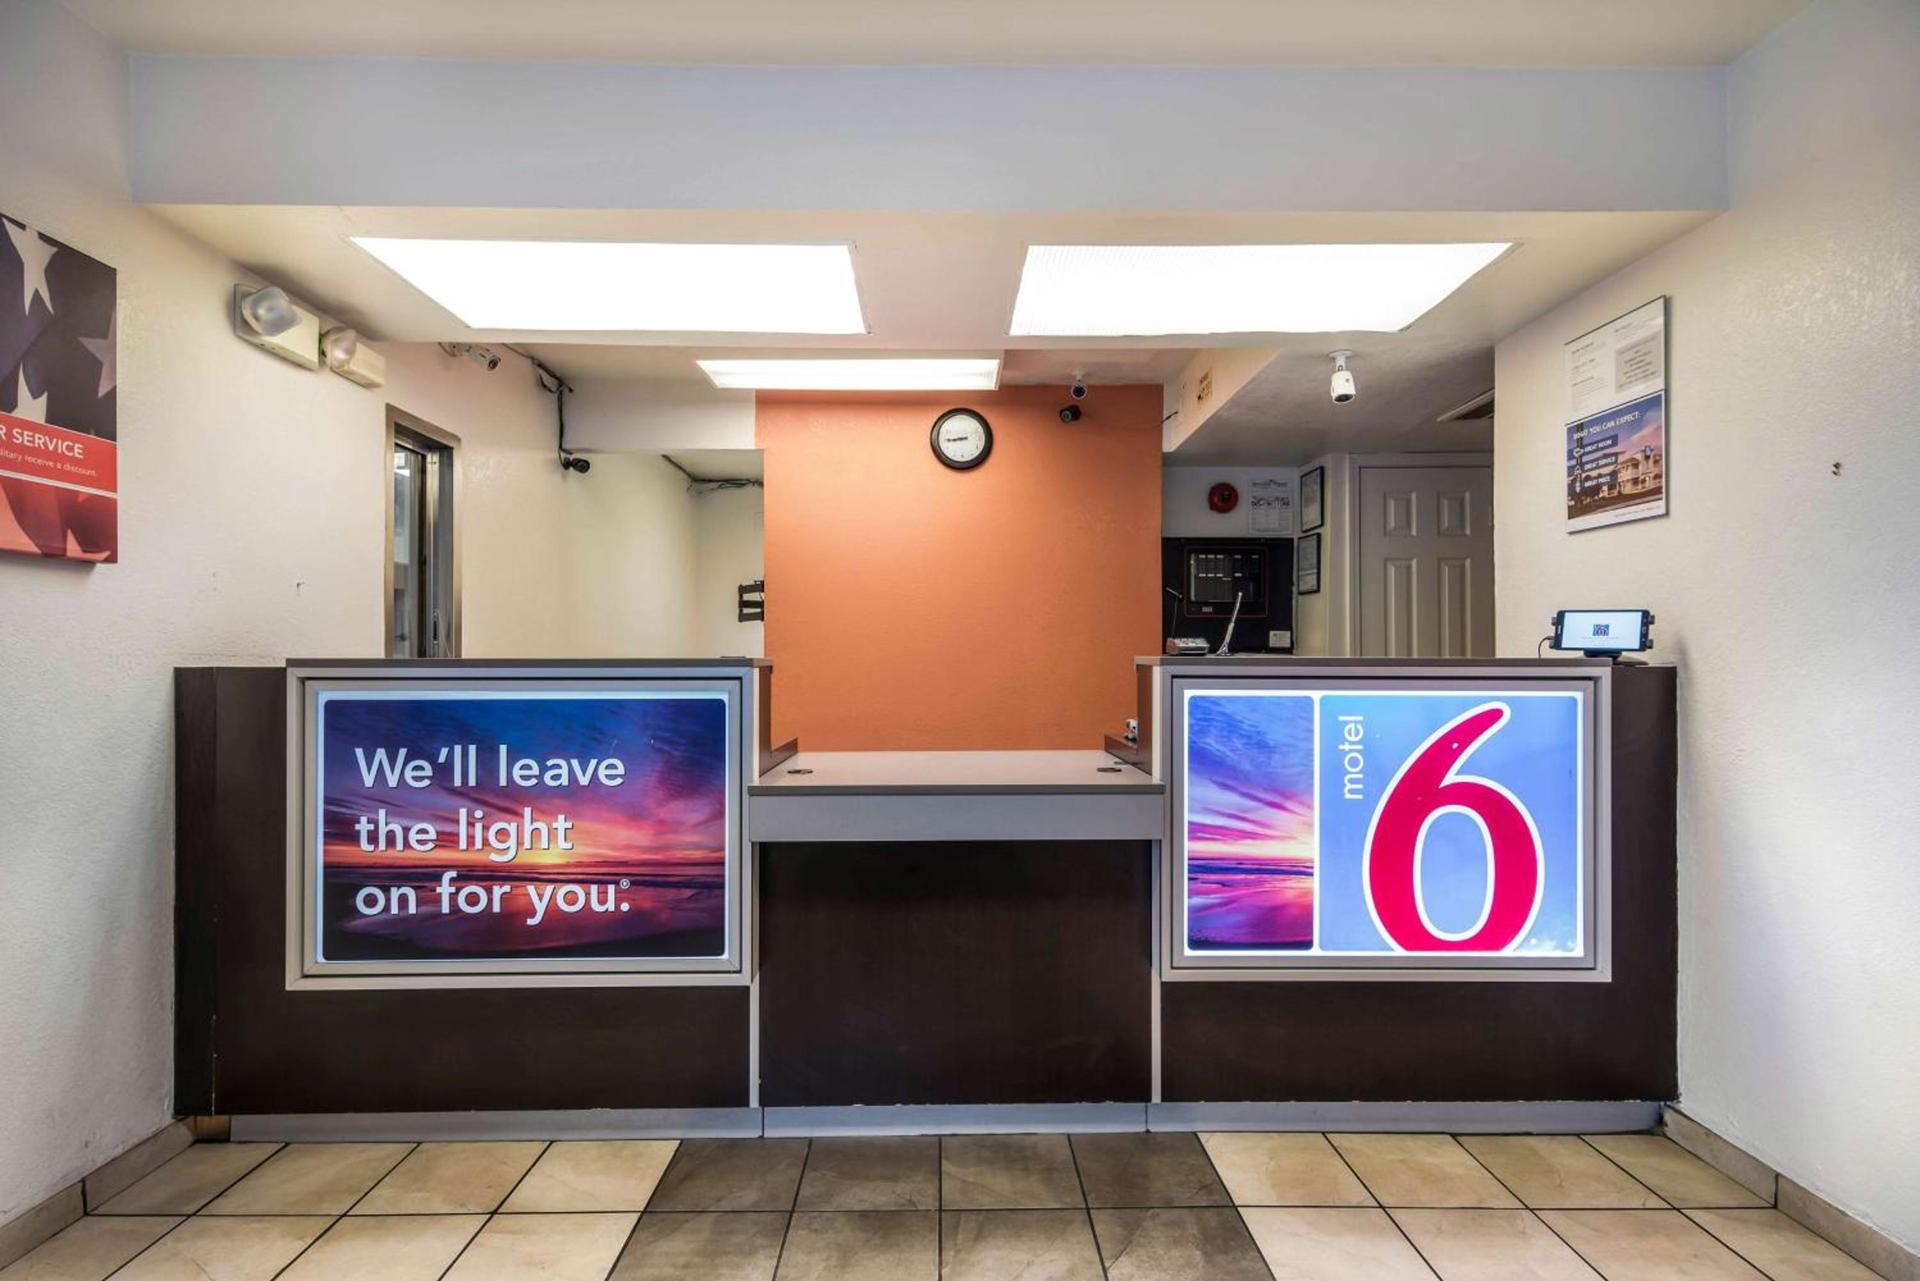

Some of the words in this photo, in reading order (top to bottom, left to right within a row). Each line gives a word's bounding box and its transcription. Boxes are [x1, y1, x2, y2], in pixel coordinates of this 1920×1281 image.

[12, 427, 84, 459] SERVICE
[1602, 420, 1615, 430] CAN
[25, 455, 55, 468] receive
[354, 744, 477, 788] We'll
[499, 744, 626, 788] leave
[354, 808, 438, 852] the
[458, 807, 574, 863] light
[1339, 715, 1363, 800] motel
[1362, 701, 1545, 951] 6
[355, 884, 418, 916] on
[436, 871, 512, 915] for
